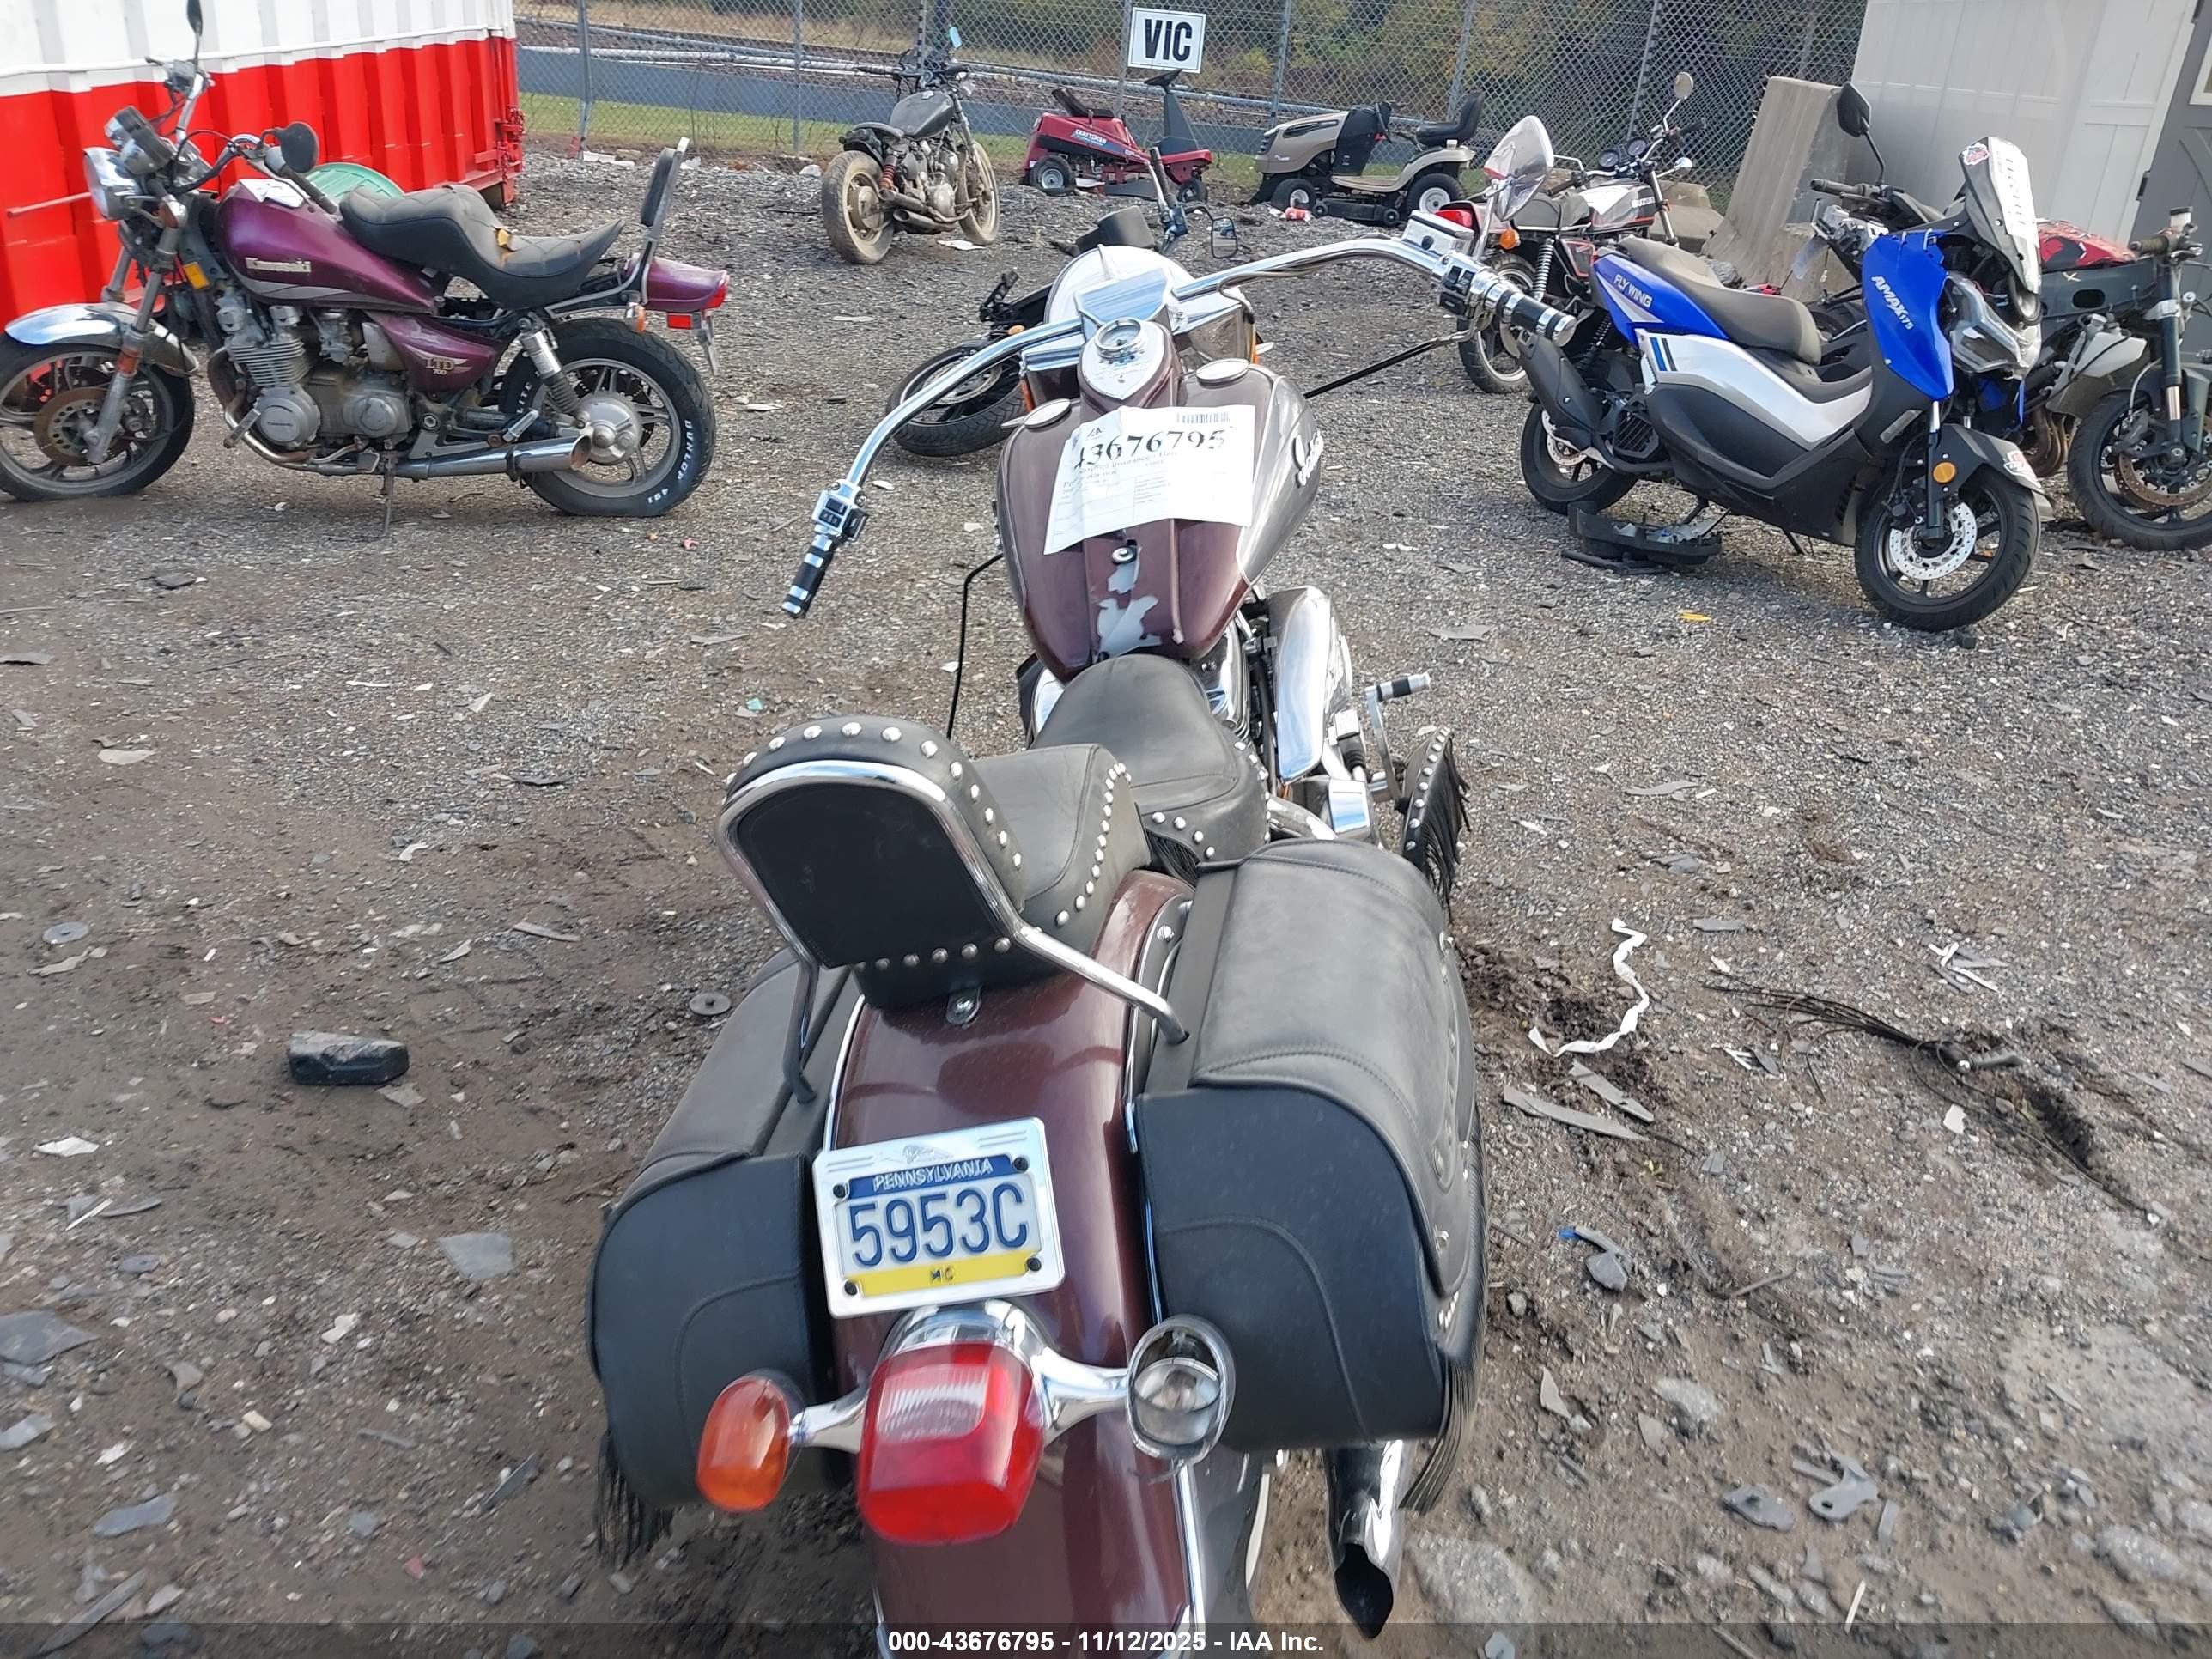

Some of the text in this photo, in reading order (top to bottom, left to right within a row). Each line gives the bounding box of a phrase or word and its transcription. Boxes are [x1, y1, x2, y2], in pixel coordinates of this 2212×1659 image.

[1145, 18, 1192, 62] VIC
[1613, 274, 1653, 308] FLY WING
[425, 356, 454, 371] LTD
[647, 419, 694, 504] DUNLOP 491
[872, 1158, 994, 1192] PENNSYLVANIA
[848, 1182, 1029, 1267] 5953C
